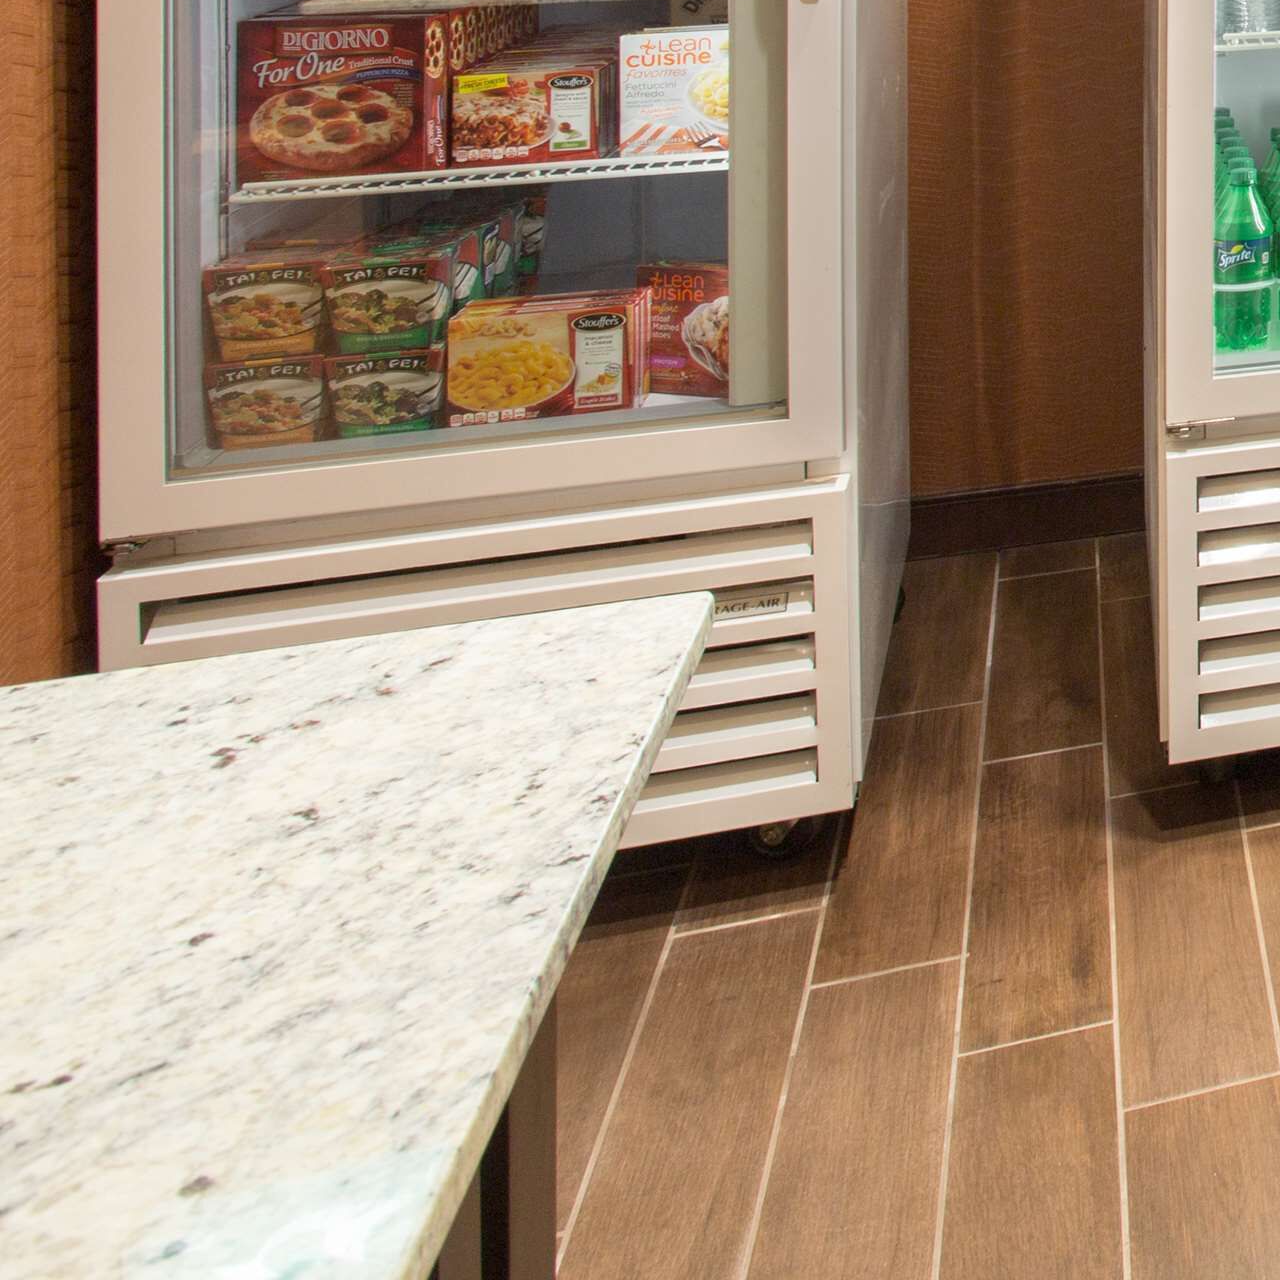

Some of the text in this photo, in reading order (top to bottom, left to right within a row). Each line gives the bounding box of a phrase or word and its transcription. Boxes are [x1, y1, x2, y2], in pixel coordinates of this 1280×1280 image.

[253, 52, 414, 88] For One Traditional Crust
[553, 75, 590, 87] Stouffer's
[1219, 249, 1252, 268] Sprite
[226, 270, 255, 286] TAI
[344, 268, 372, 282] TAI
[578, 314, 620, 328] Stouffer's
[346, 360, 374, 374] TAI
[226, 368, 254, 382] TAI
